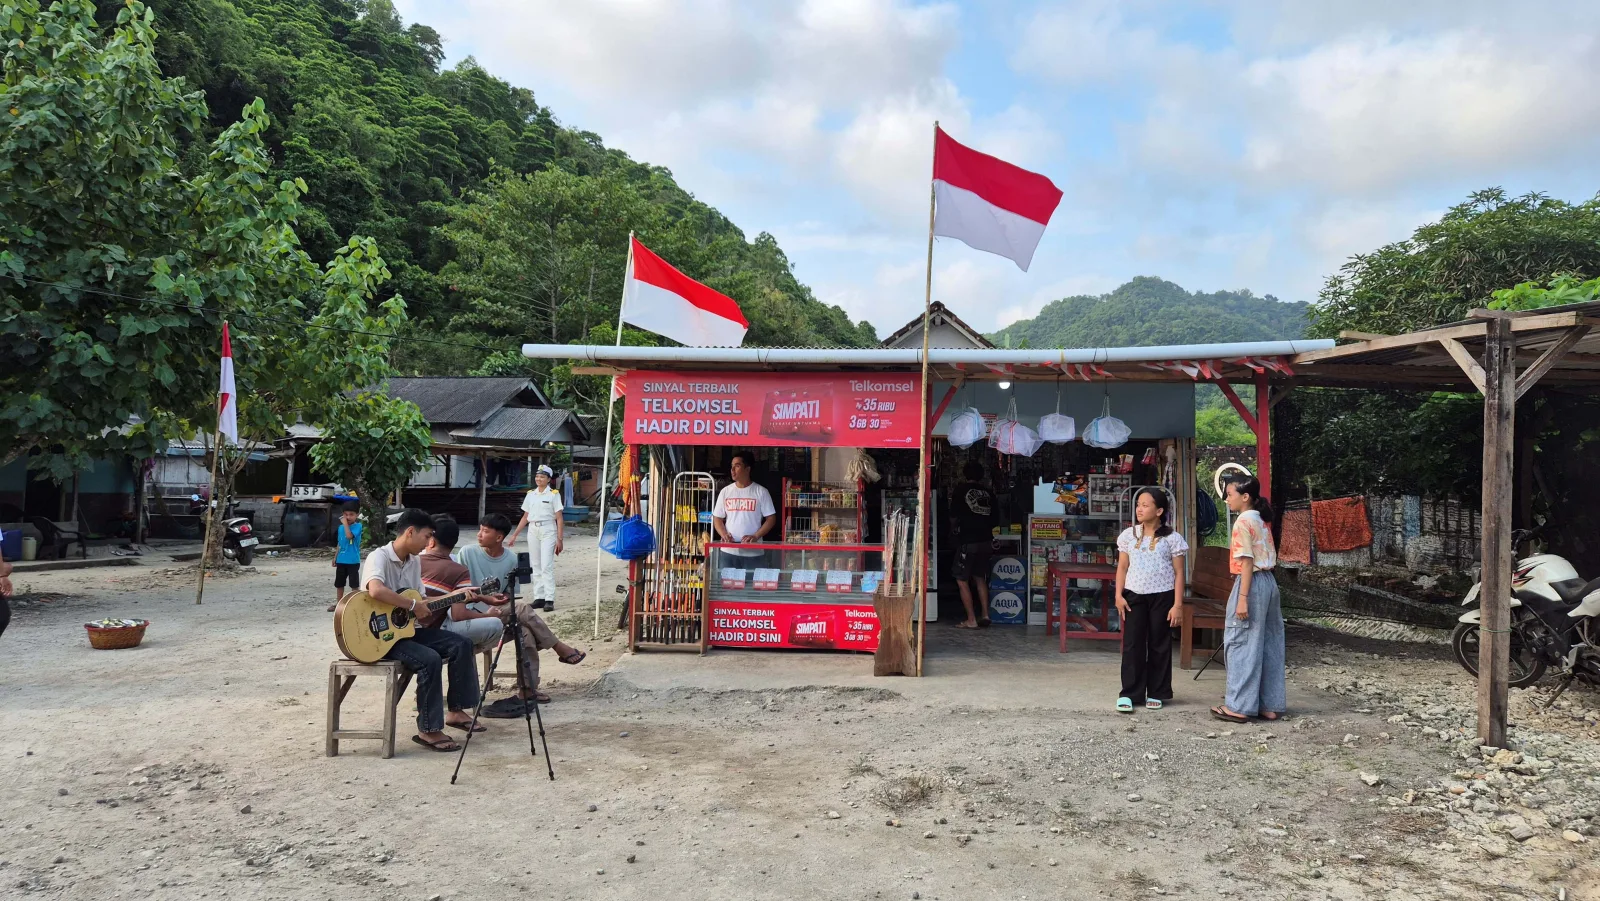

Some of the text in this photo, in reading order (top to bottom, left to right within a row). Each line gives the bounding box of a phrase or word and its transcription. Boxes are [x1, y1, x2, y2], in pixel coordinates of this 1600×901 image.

[643, 382, 739, 394] SINYAL TERBAIK
[849, 380, 914, 392] Telkomsel
[642, 398, 742, 414] TELKOMSEL
[772, 400, 820, 420] SIMPATI
[863, 398, 877, 411] 35
[877, 402, 895, 411] RIBU
[636, 419, 749, 434] HADIR DI SINI
[849, 415, 857, 428] 3
[857, 418, 867, 428] GB
[869, 418, 880, 429] 30
[726, 499, 756, 510] SIMPATI
[997, 564, 1021, 574] AQUA
[995, 600, 1018, 608] AQUA
[844, 610, 878, 618] Telkoms
[713, 618, 776, 630] TELKOMSEL
[796, 622, 826, 634] SIMPATI
[709, 632, 780, 642] HADIR DI SINI
